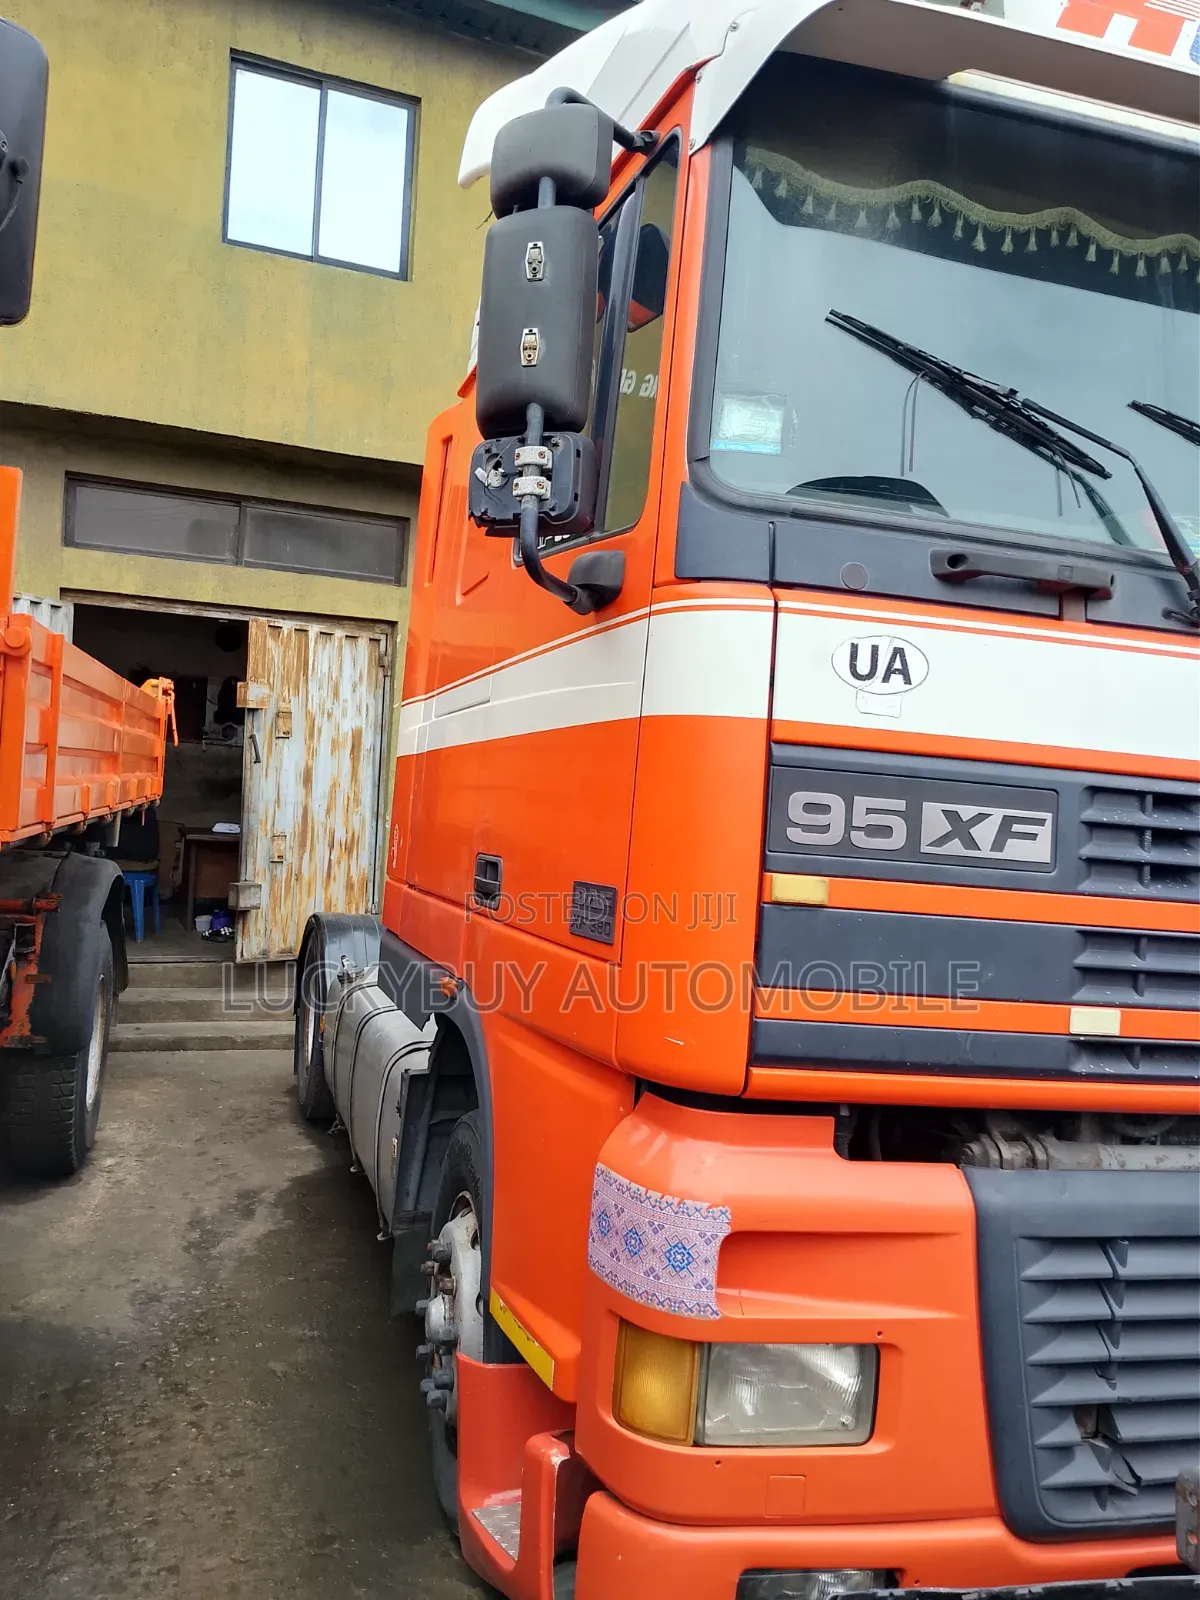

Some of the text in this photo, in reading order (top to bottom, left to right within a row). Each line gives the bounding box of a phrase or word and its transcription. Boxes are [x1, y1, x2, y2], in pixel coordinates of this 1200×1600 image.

[848, 642, 912, 686] UA
[786, 791, 1048, 854] 95 XF
[589, 918, 611, 939] 380
